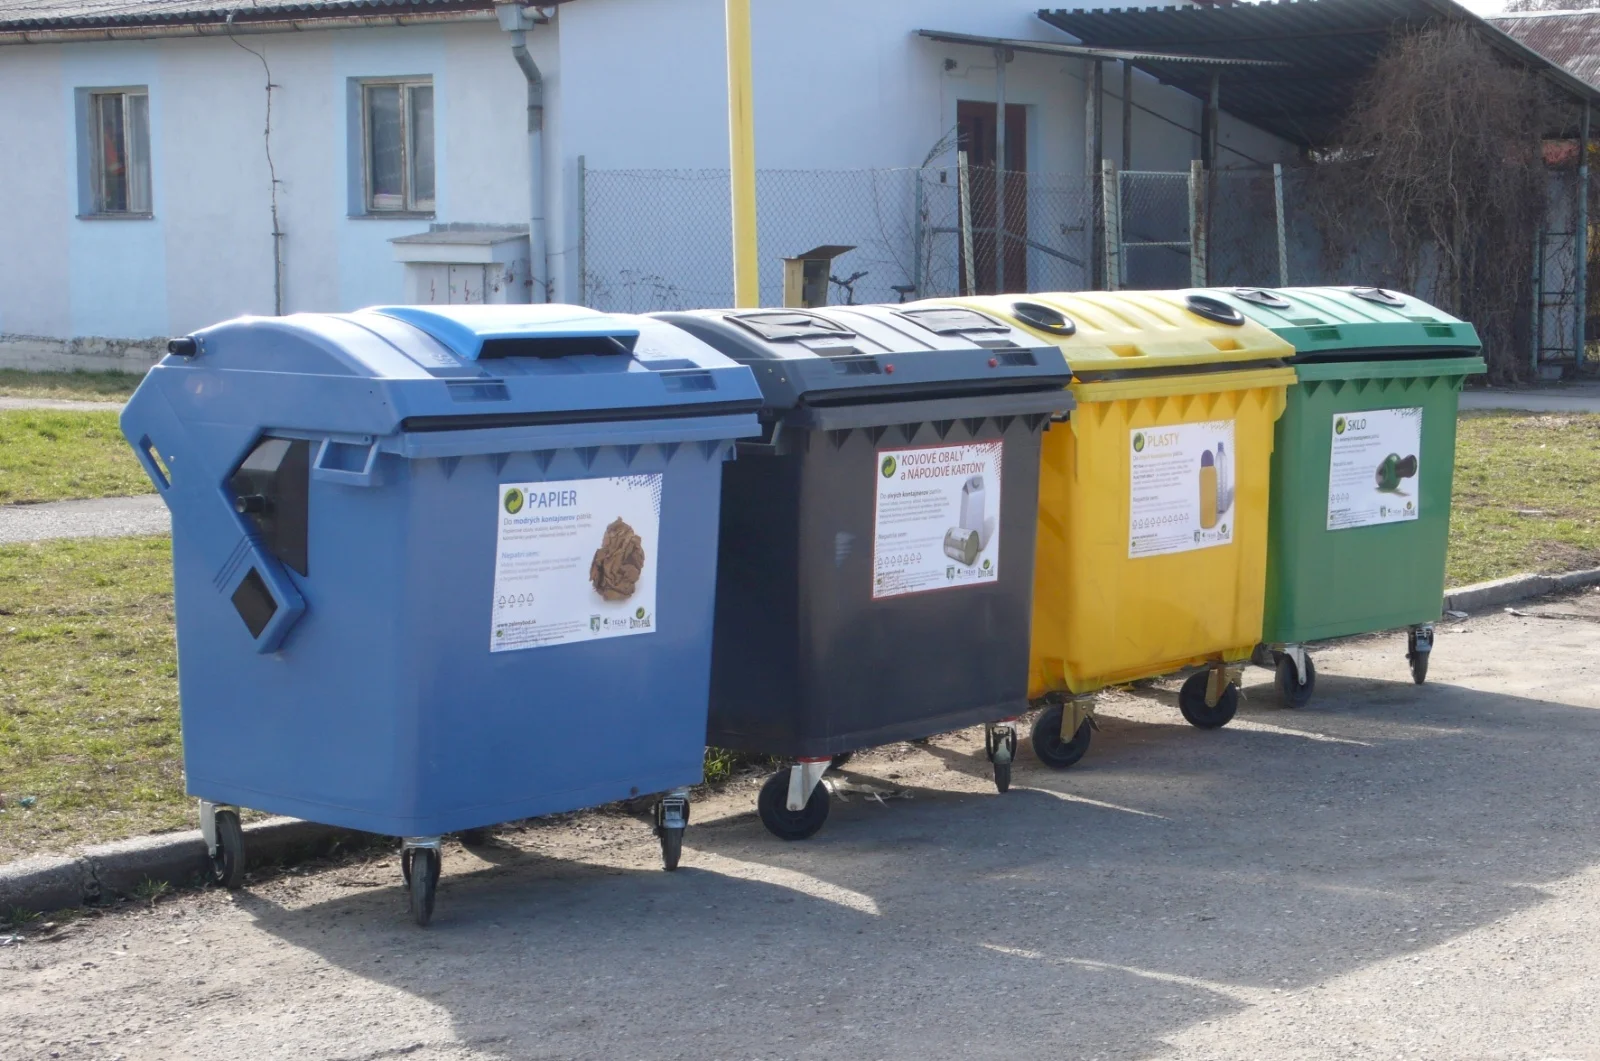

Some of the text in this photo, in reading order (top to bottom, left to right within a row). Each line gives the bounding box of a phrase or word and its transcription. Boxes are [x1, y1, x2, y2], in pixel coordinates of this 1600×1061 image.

[1347, 419, 1367, 431] SKLO
[1147, 432, 1180, 447] PLASTY
[901, 450, 965, 466] KOVOVÉ OBALY
[900, 471, 906, 480] a
[907, 464, 950, 480] NÁPOJOVÉ
[528, 490, 577, 509] PAPIER
[503, 517, 512, 525] Do
[513, 516, 540, 526] modrých
[541, 513, 575, 524] kontajnerov
